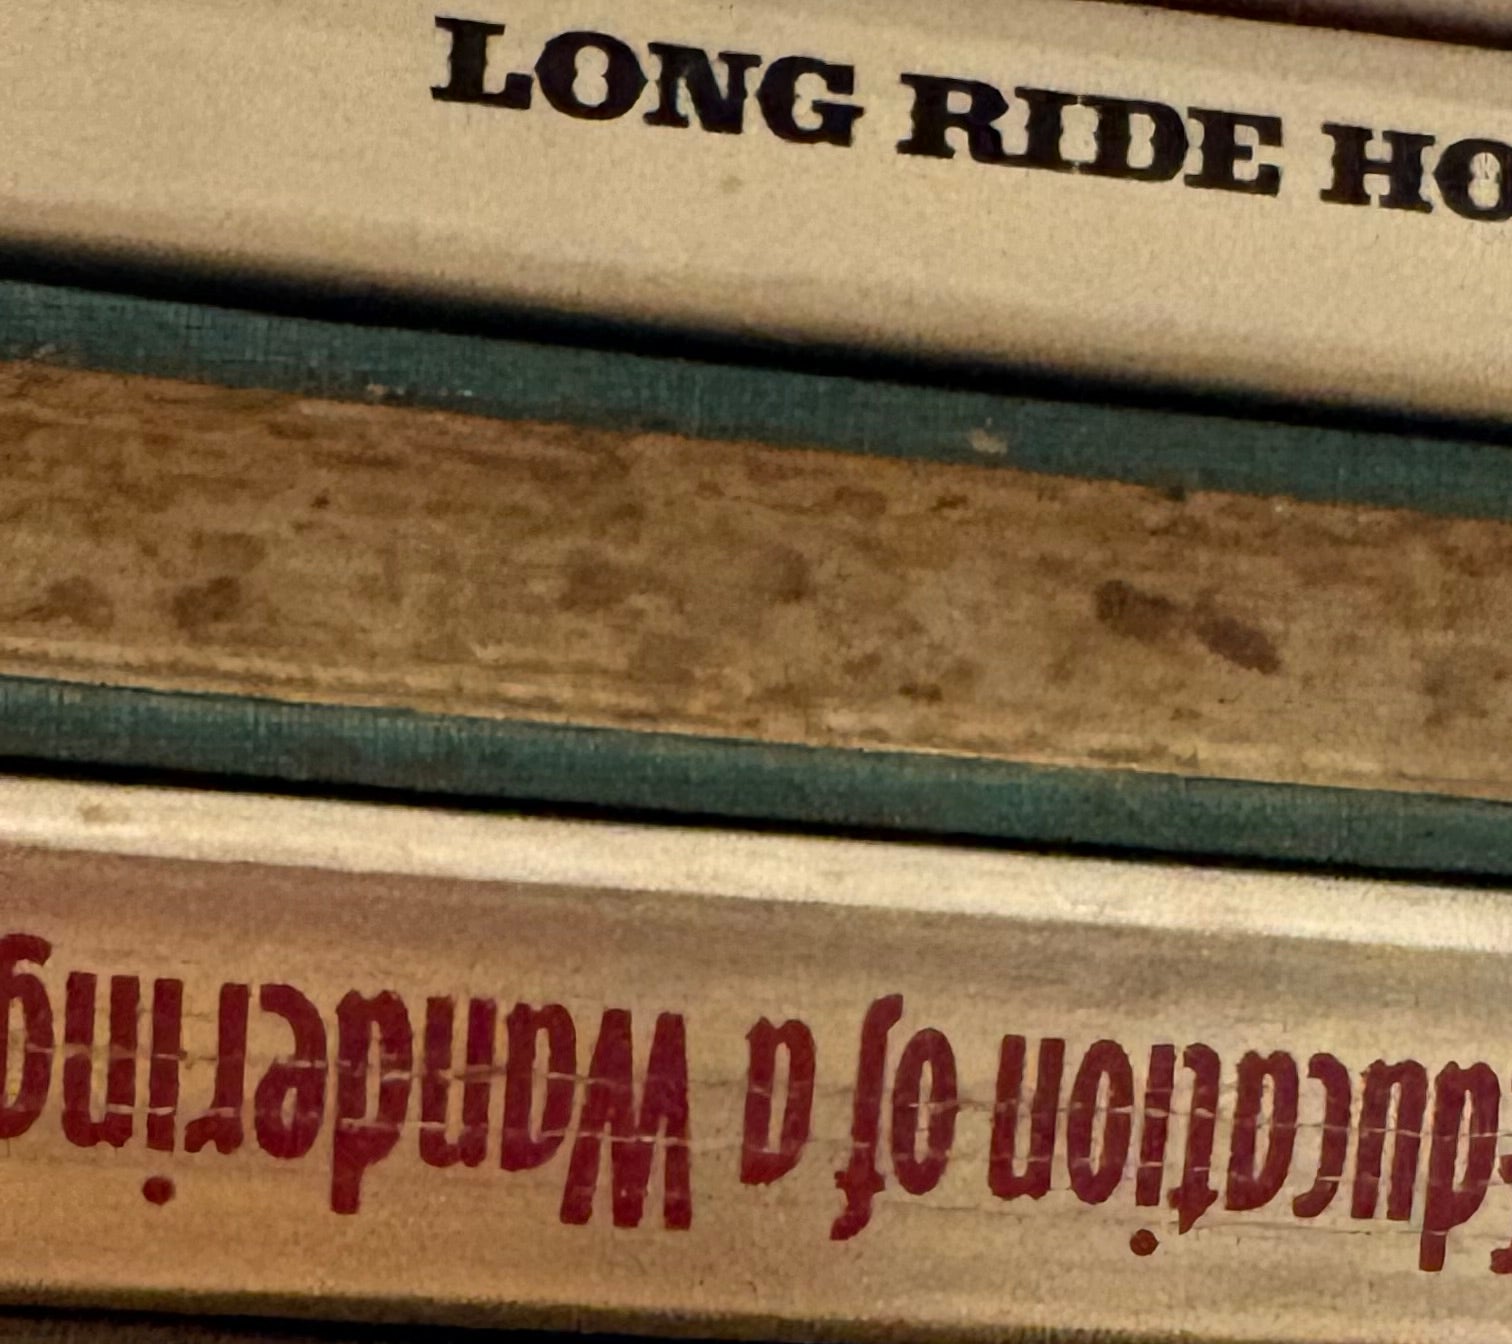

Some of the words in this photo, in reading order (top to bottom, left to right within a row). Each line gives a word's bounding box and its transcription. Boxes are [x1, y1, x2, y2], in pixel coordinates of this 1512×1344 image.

[430, 16, 864, 148] LONG
[897, 73, 1283, 197] RIDE
[0, 932, 691, 1228] Wandering
[741, 1024, 814, 1183] a
[832, 997, 958, 1240] of
